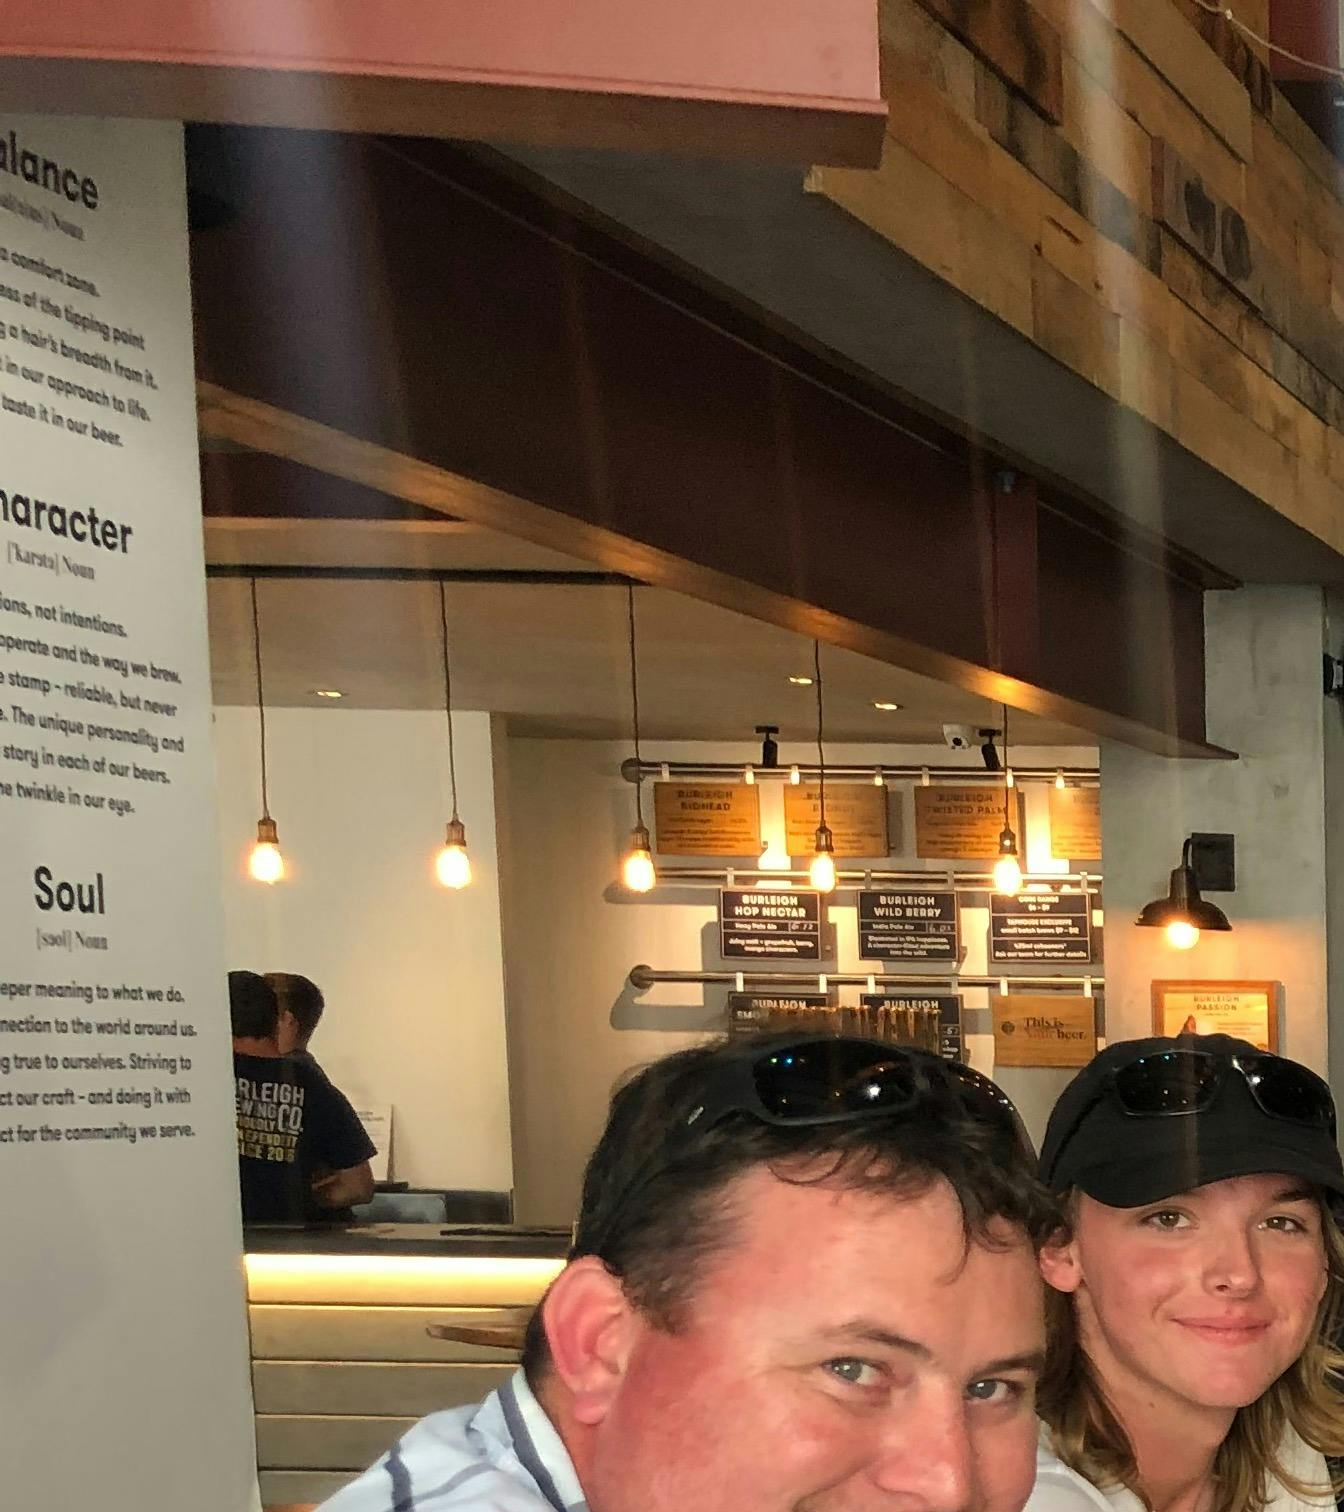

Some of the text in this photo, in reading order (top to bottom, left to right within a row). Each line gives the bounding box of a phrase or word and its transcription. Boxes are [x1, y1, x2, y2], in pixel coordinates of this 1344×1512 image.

[64, 304, 111, 342] tipping
[60, 338, 113, 373] breadth
[114, 358, 144, 384] from
[21, 366, 44, 384] our
[47, 374, 110, 406] approach
[112, 395, 126, 413] to
[1, 393, 36, 419] taste
[38, 403, 50, 424] it
[51, 406, 65, 428] in
[66, 417, 88, 435] our
[35, 604, 128, 638] not intentions.
[52, 645, 78, 663] and
[79, 650, 100, 667] the
[102, 656, 129, 678] way
[131, 661, 148, 677] we
[8, 671, 51, 697] stamp
[119, 690, 142, 711] but
[144, 700, 178, 717] never
[11, 704, 185, 754] The unique personality and
[3, 743, 171, 784] story in each of our beers.
[16, 782, 66, 804] twinkle
[68, 786, 81, 805] in
[84, 794, 105, 809] our
[34, 865, 105, 915] Soul
[742, 894, 798, 906] BURLEIGH
[879, 895, 935, 905] BURLEIGH
[734, 906, 806, 918] HOP NECTAR
[873, 907, 941, 918] WILD BERRY
[35, 980, 94, 1003] meaning
[96, 984, 109, 1000] to
[112, 983, 144, 1001] what
[146, 989, 163, 1001] we
[166, 986, 185, 1003] do.
[55, 1018, 68, 1034] to
[72, 1017, 92, 1034] the
[96, 1017, 131, 1035] world
[134, 1020, 178, 1036] around
[181, 1024, 198, 1037] us.
[14, 1052, 192, 1075] true to ourselves. Striving to
[16, 1092, 39, 1106] our
[42, 1088, 75, 1106] craft
[88, 1088, 113, 1105] and
[116, 1087, 151, 1109] doing
[154, 1087, 163, 1105] it
[166, 1087, 191, 1104] with
[238, 1077, 305, 1107] RLEIGH
[17, 1121, 196, 1144] for the community we serve.
